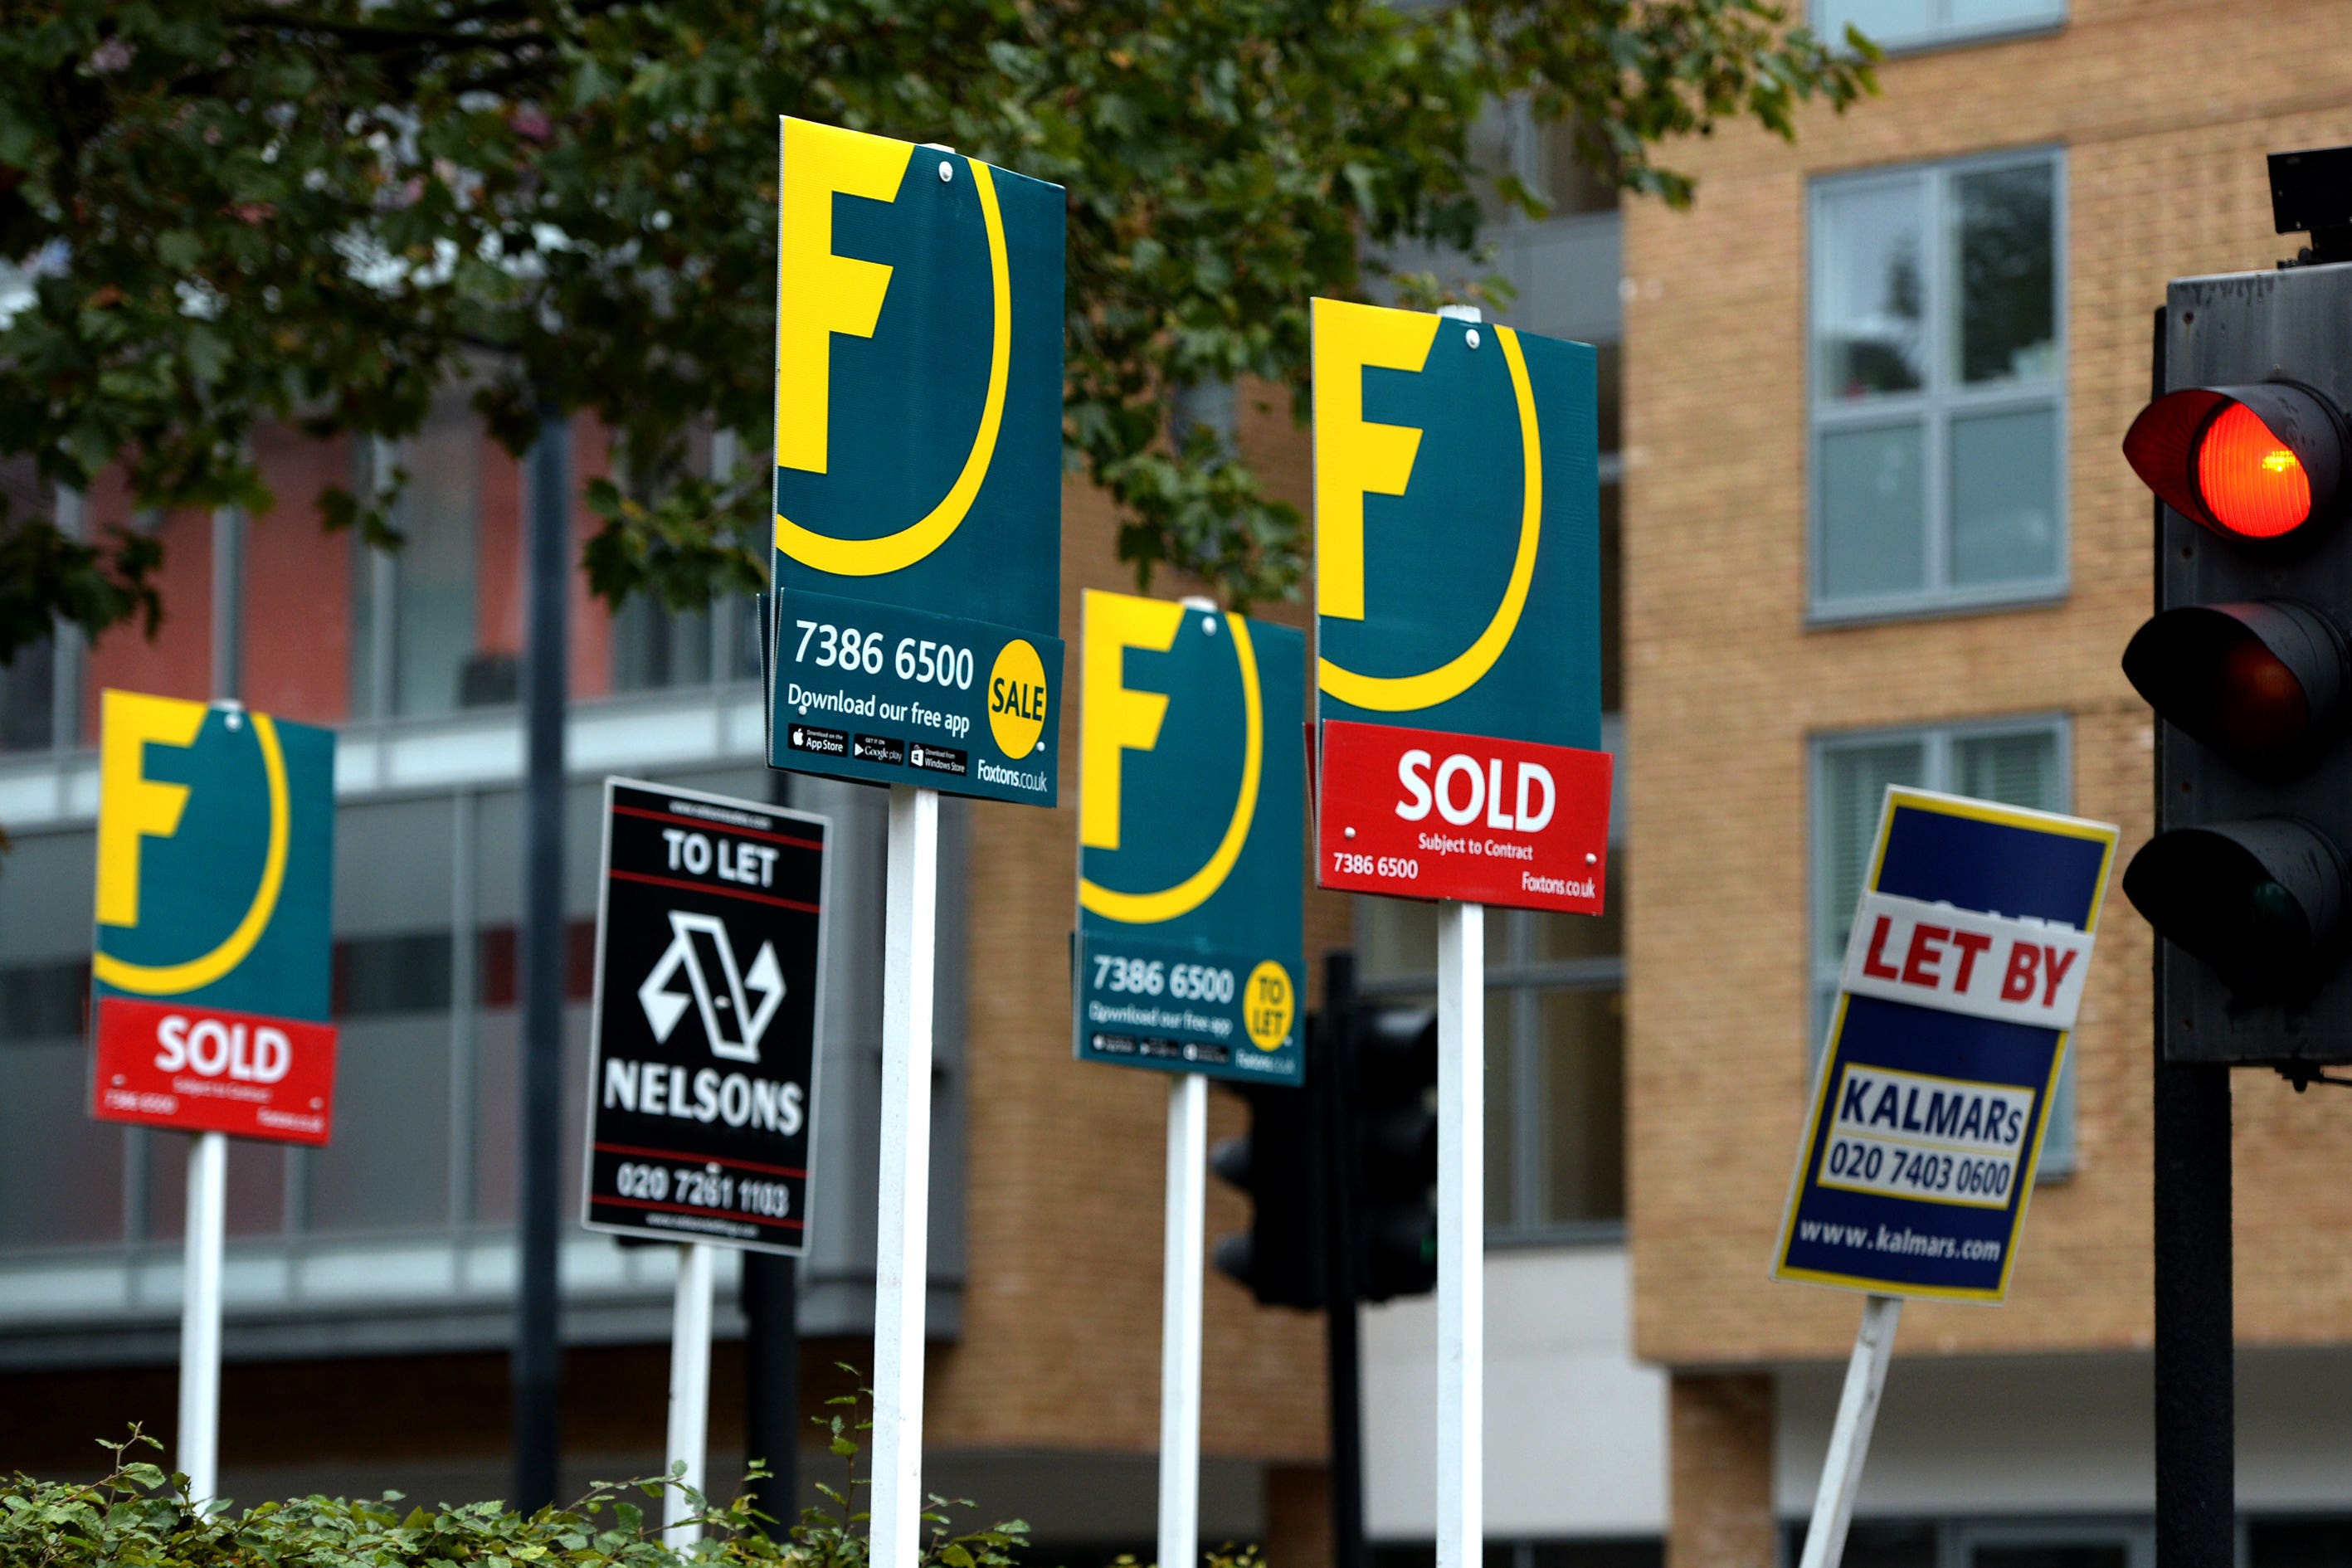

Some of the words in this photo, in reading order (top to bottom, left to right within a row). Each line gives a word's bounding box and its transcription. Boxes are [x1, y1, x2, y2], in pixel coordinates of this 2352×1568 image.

[795, 620, 884, 675] 7386
[895, 637, 974, 690] 6500
[787, 683, 876, 718] Download
[879, 703, 908, 722] our
[911, 702, 942, 728] free
[944, 713, 971, 739] app
[991, 677, 1045, 722] SALE
[806, 729, 828, 739] Download
[806, 737, 822, 751] App
[823, 739, 844, 752] Store
[864, 746, 889, 761] Google
[889, 750, 903, 762] play
[925, 748, 946, 757] Download
[925, 757, 951, 771] Windows
[951, 762, 965, 773] Store
[977, 759, 1048, 793] Foxtons.co.uk
[1395, 749, 1556, 833] SOLD
[663, 828, 711, 874] TO
[717, 839, 780, 888] LET
[1333, 852, 1374, 875] 7386
[1377, 858, 1419, 879] 6500
[1418, 832, 1465, 856] Subject
[1468, 840, 1483, 855] to
[1484, 840, 1533, 860] Contract
[1522, 871, 1595, 898] Foxtons.co.uk
[1093, 955, 1164, 996] 7386
[1169, 963, 1234, 1005] 6500
[1863, 915, 1993, 993] LET
[2000, 940, 2079, 1008] BY
[1259, 976, 1285, 1005] TO
[1253, 1008, 1283, 1037] LET
[154, 1014, 292, 1084] SOLD
[603, 1056, 803, 1136] NELSONS
[1830, 1140, 1882, 1181] 020
[1888, 1149, 1954, 1191] 7403
[1956, 1159, 2011, 1197] 0600
[616, 1162, 670, 1201] 020
[738, 1176, 790, 1219] 1103
[1799, 1219, 2001, 1262] www.kalmars.com
